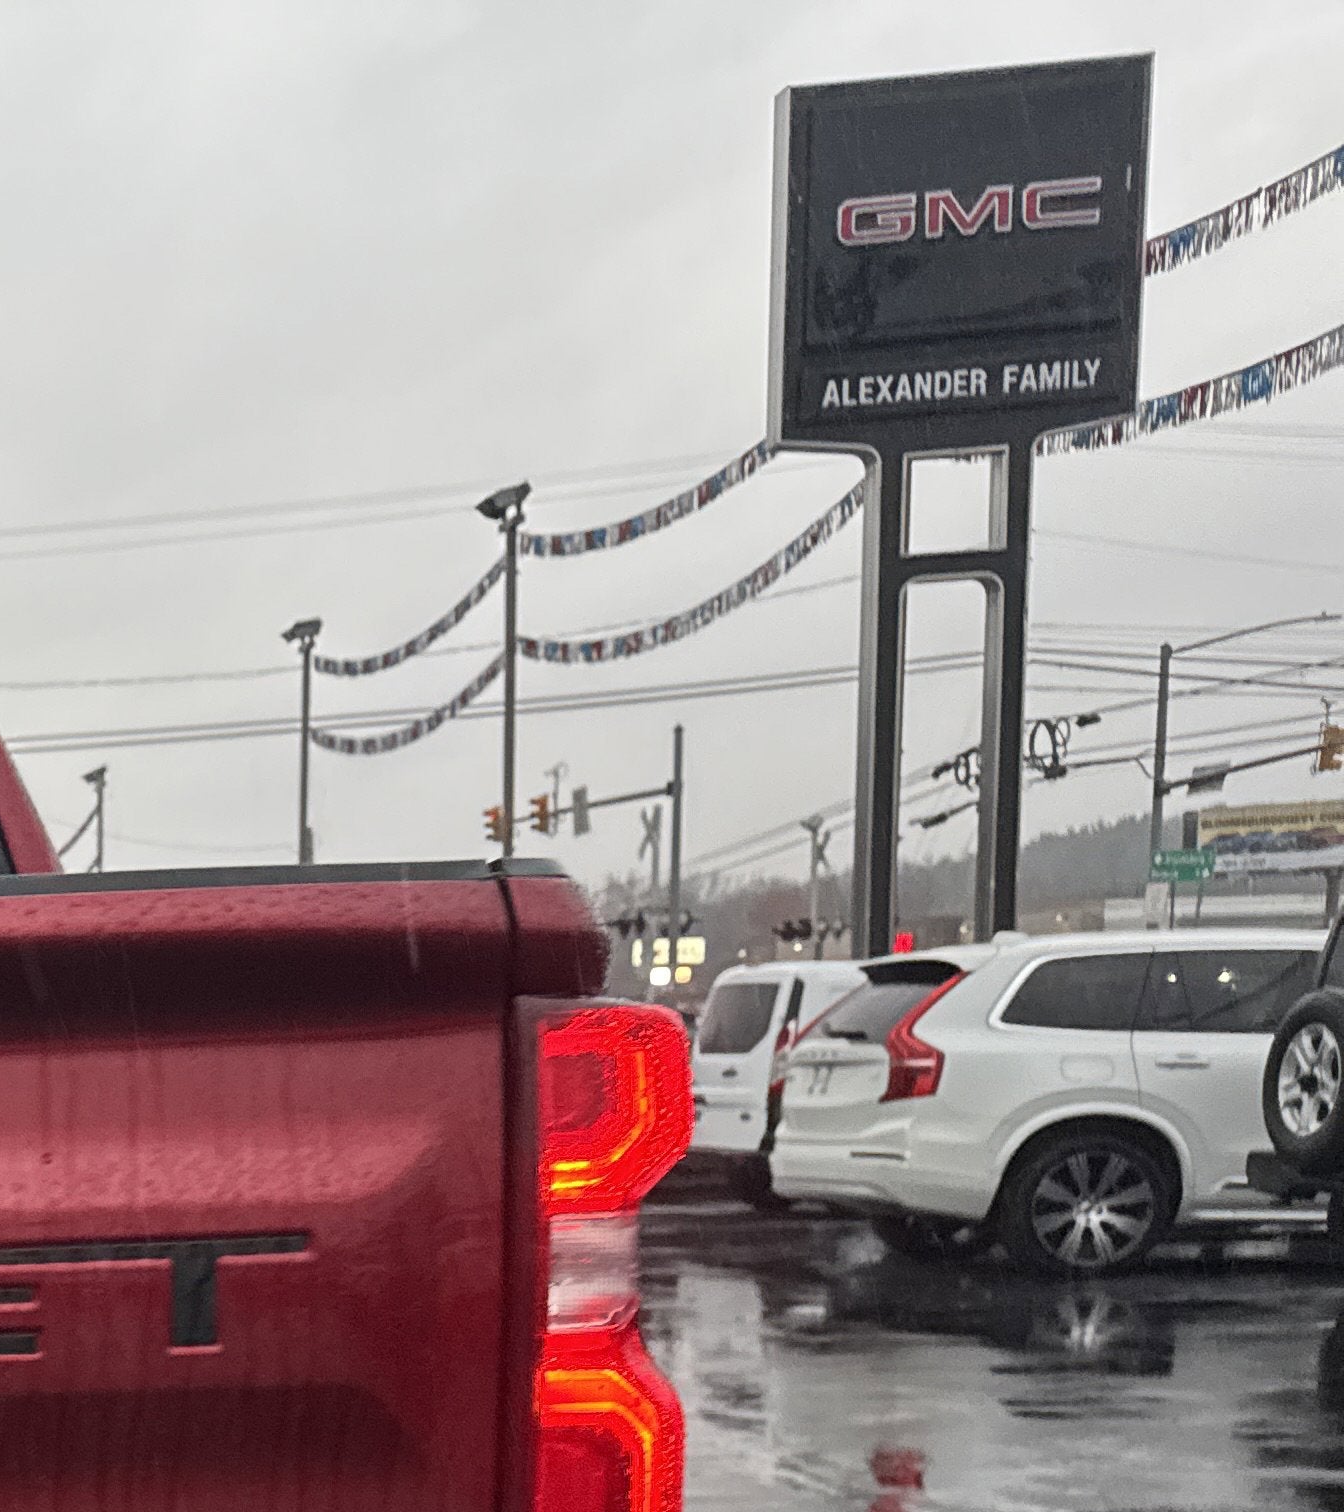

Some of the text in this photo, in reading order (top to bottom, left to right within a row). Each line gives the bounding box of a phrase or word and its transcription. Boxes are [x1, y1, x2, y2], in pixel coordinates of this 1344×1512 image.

[837, 176, 1102, 247] GMC
[821, 357, 1102, 409] ALEXANDER FAMILY
